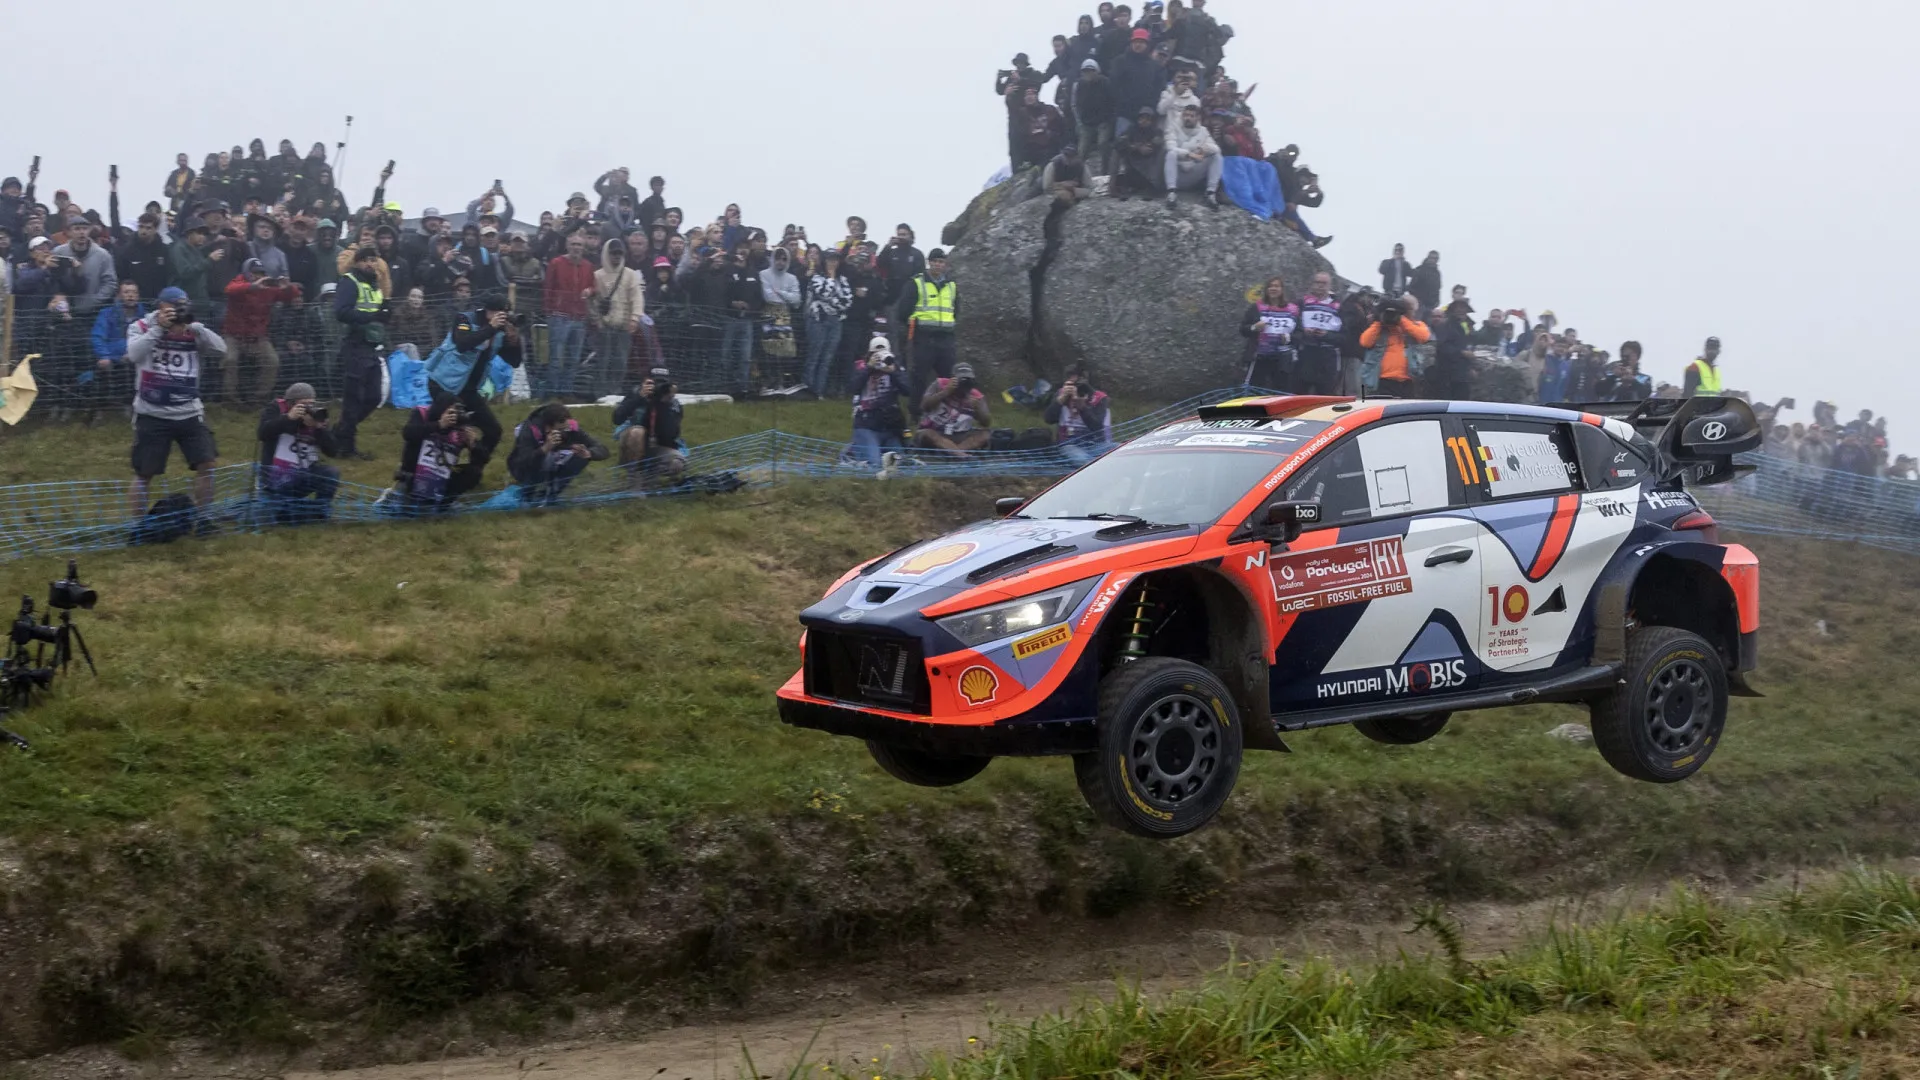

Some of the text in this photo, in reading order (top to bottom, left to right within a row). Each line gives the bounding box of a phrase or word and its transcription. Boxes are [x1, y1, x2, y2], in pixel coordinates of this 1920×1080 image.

[1311, 313, 1333, 324] 437
[1503, 439, 1559, 458] Neuville
[1264, 426, 1345, 490] motorsport.hyundai.com
[1446, 436, 1480, 485] 11
[1666, 499, 1689, 507] STEEL
[1295, 504, 1316, 518] ixo
[1305, 557, 1330, 567] rally de
[1374, 540, 1401, 577] HY
[1305, 557, 1371, 579] Portugal
[1278, 580, 1305, 590] vodafone
[1327, 581, 1408, 604] FOSSIL-FREE FUEL
[1282, 597, 1315, 612] WRC
[1499, 628, 1519, 637] YEARS
[1016, 627, 1067, 656] PIRELLI
[1488, 636, 1528, 648] of Strategic
[1488, 646, 1529, 658] Partnership
[1317, 659, 1468, 698] HYUNDAI MOBIS
